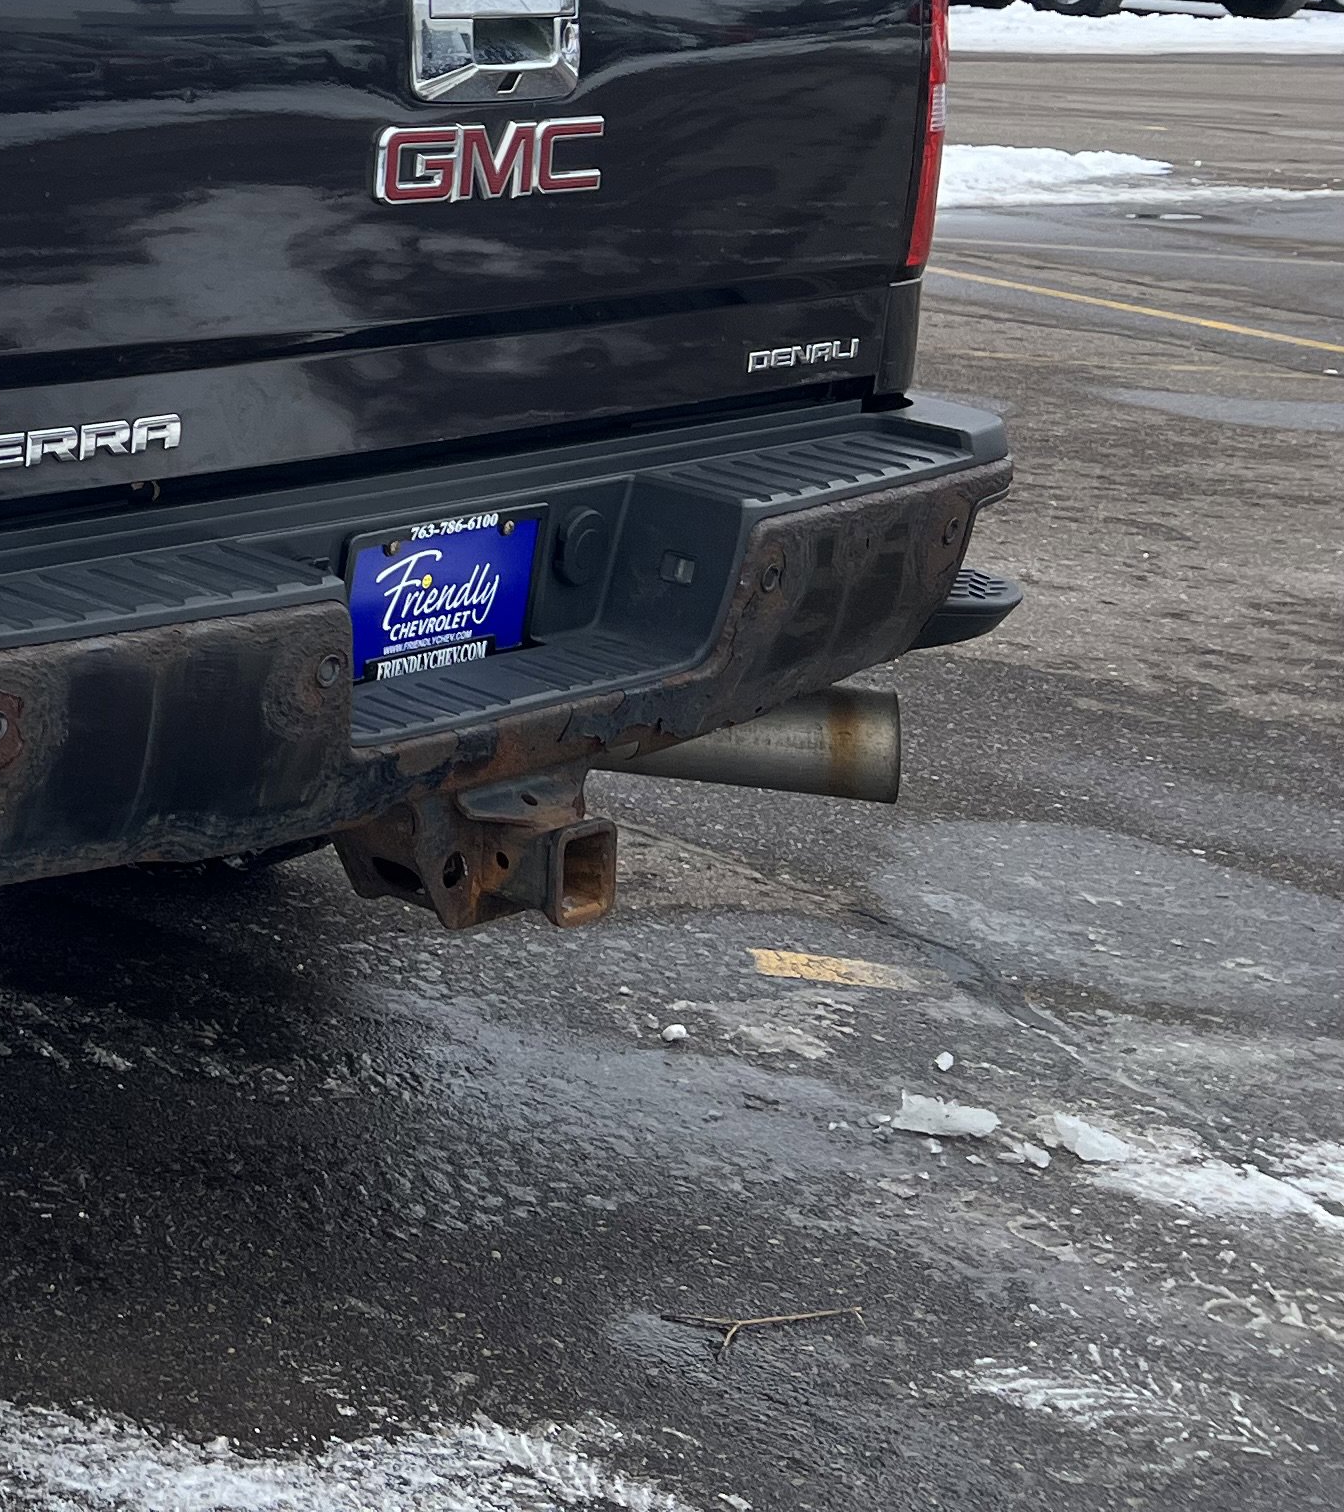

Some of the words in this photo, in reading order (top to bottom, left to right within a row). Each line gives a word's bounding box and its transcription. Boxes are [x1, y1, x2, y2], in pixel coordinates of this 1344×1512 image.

[376, 115, 604, 204] GMC
[747, 338, 859, 373] DENALI
[410, 513, 499, 541] 763-786-6100
[375, 549, 500, 631] Friendly
[389, 610, 472, 641] CHEVROLET
[376, 640, 488, 681] FRIENDLYCHEV.COM
